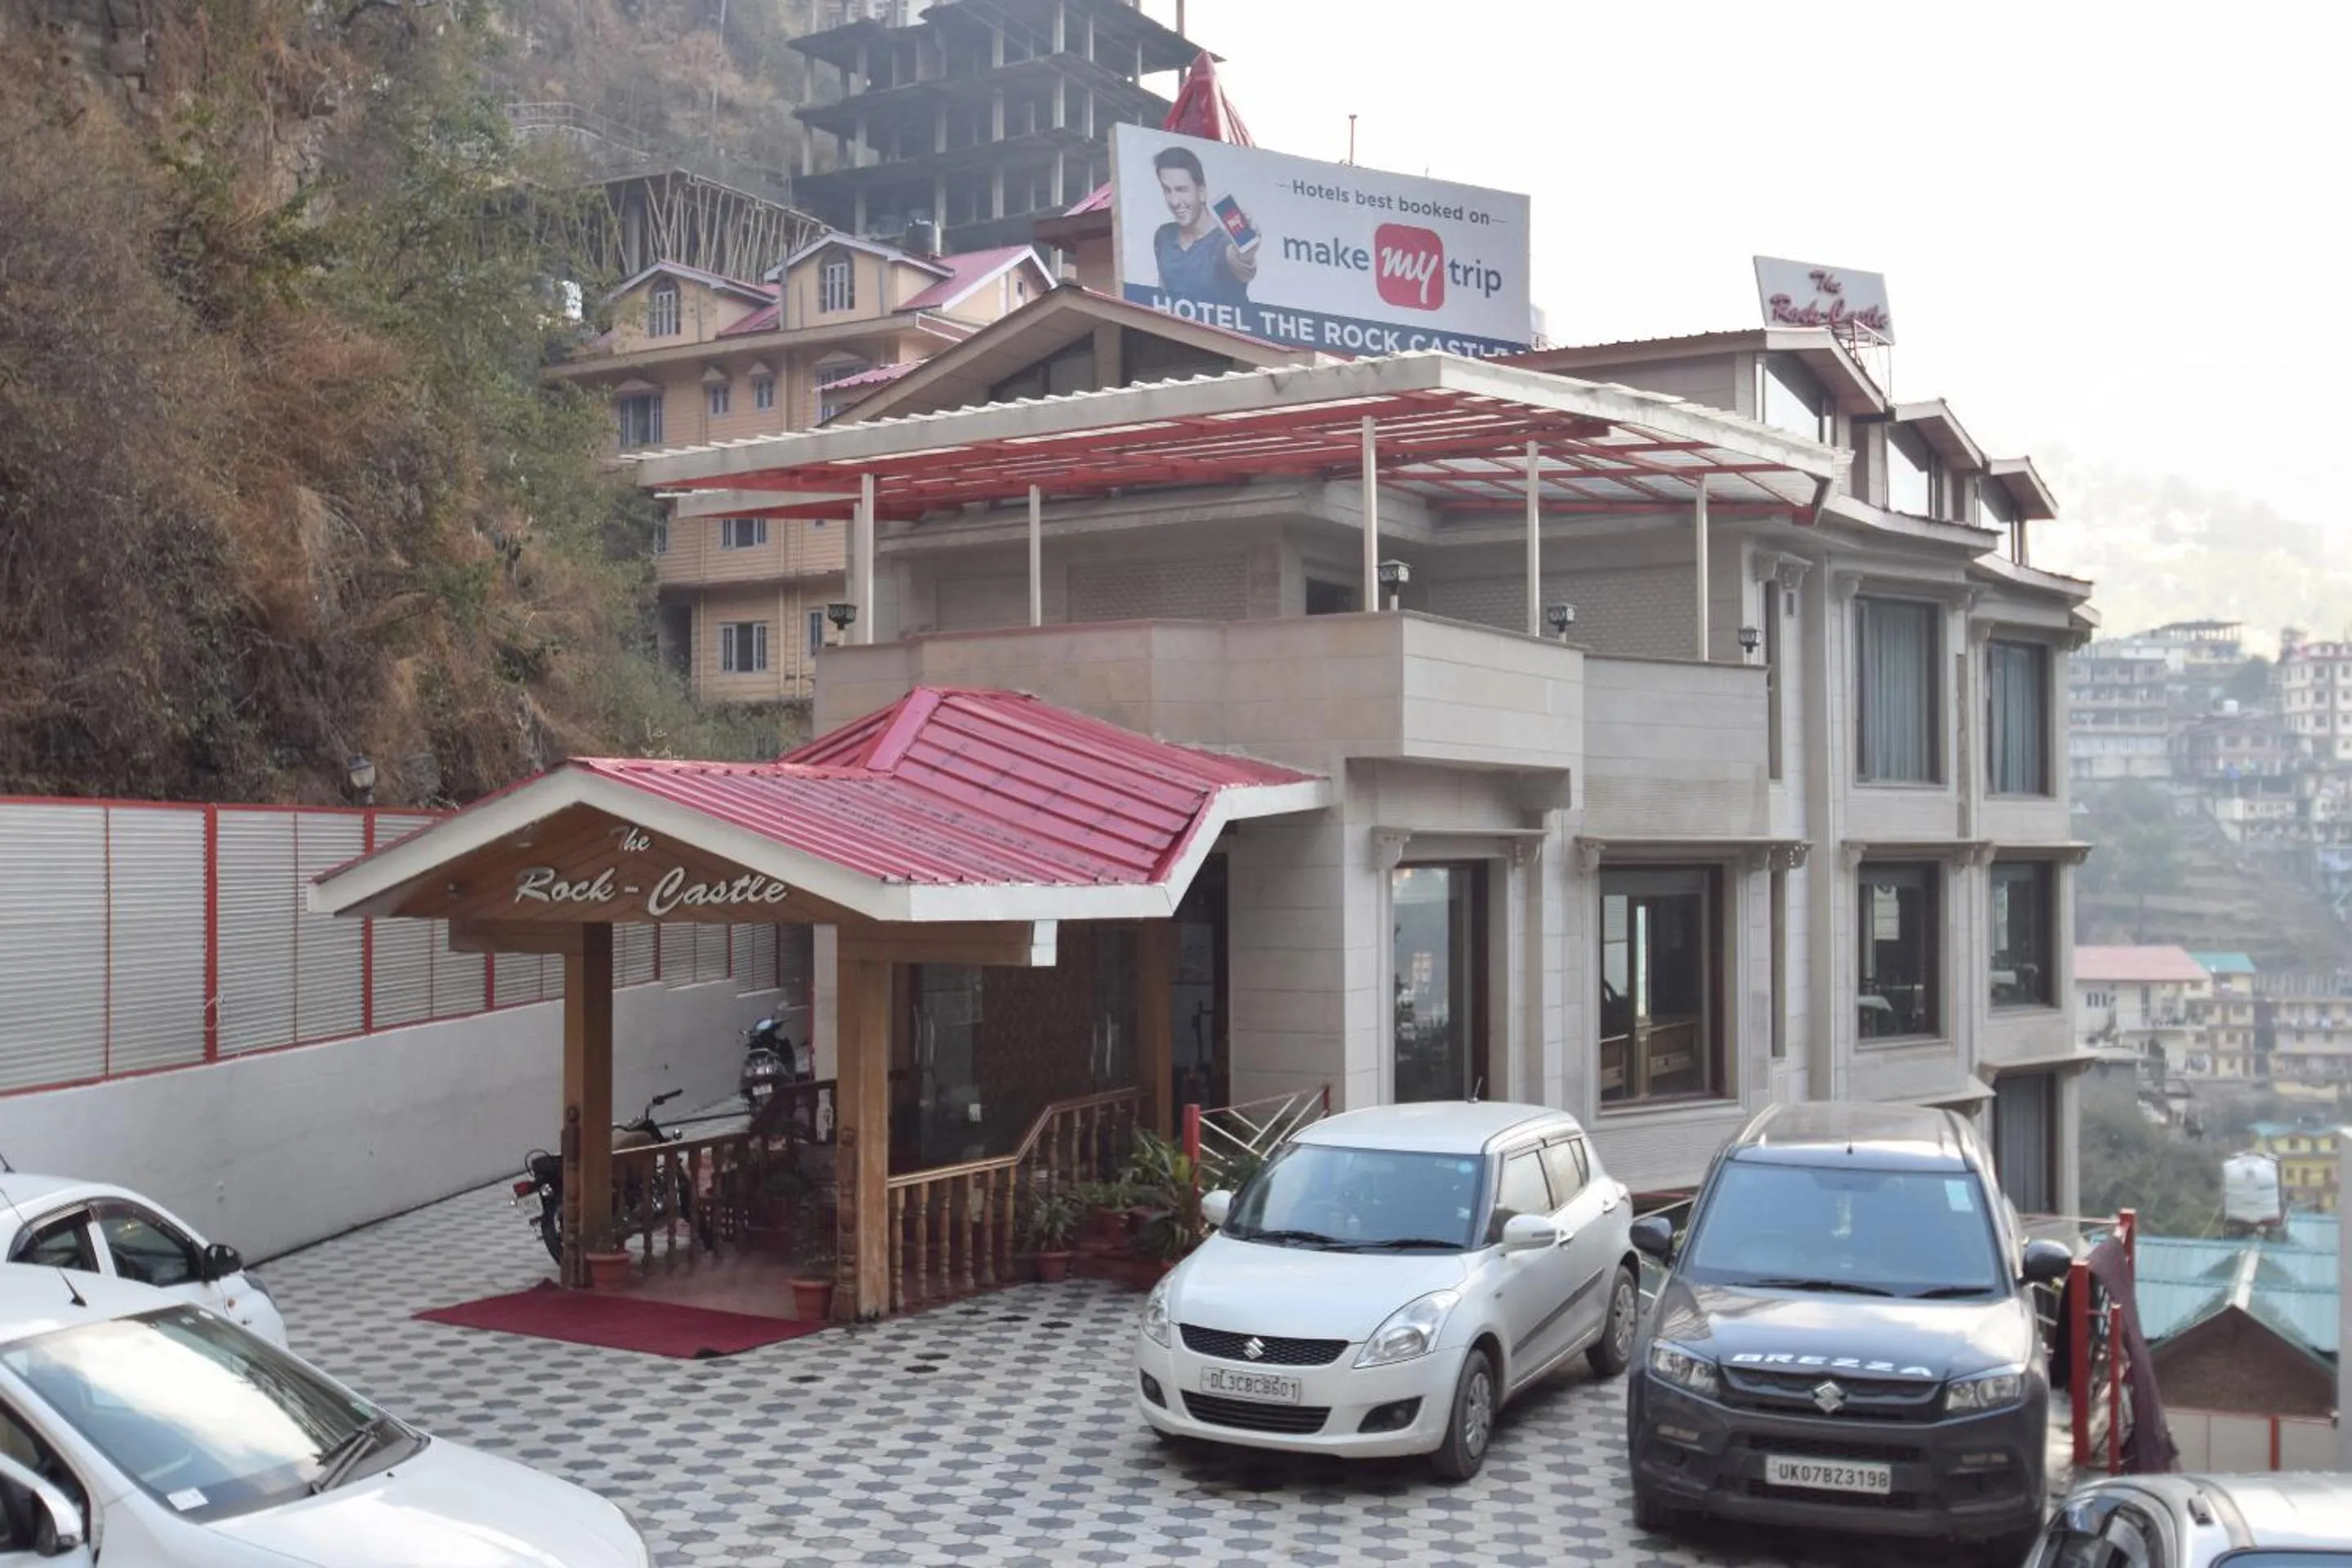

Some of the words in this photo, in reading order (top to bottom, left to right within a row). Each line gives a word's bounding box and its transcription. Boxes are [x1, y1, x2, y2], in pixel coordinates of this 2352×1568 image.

[1293, 179, 1349, 203] Hotels
[1356, 189, 1392, 210] best
[1399, 195, 1463, 220] booked
[1469, 212, 1490, 225] on
[1283, 236, 1370, 271] make
[1382, 247, 1439, 304] my
[1448, 258, 1502, 298] trip
[1152, 295, 1251, 332] HOTEL
[1259, 311, 1316, 341] THE
[1325, 321, 1402, 353] ROCK
[609, 826, 652, 853] The
[514, 866, 616, 903] Rock
[648, 866, 788, 916] Castle
[1731, 1353, 1933, 1377] BREZZA
